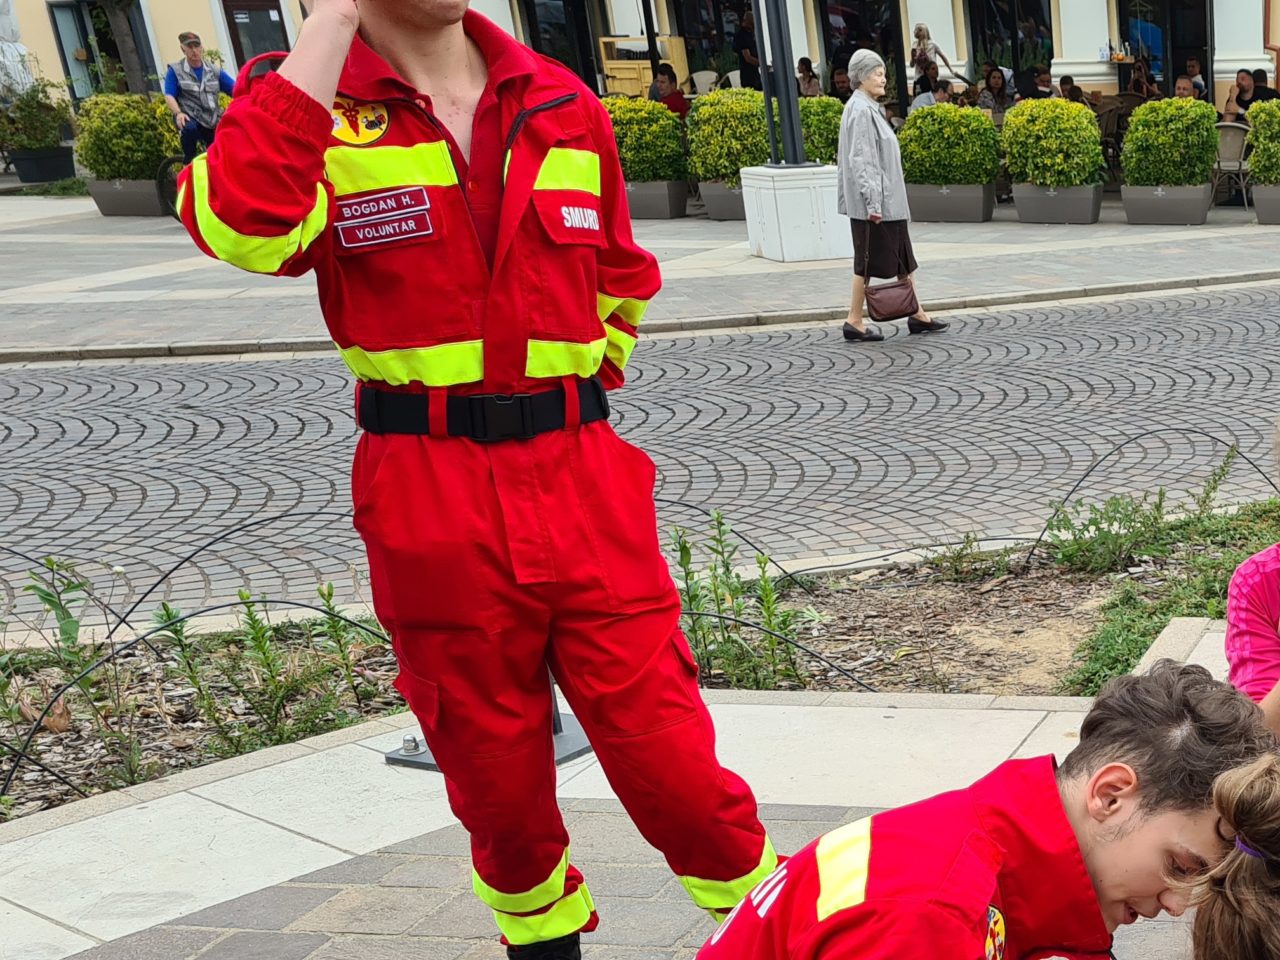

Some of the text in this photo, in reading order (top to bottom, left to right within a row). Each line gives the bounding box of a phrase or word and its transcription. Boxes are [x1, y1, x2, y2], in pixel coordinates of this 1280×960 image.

[342, 195, 415, 217] BOGDAN H.
[560, 205, 600, 231] SMURD
[356, 220, 417, 239] VOLUNTAR
